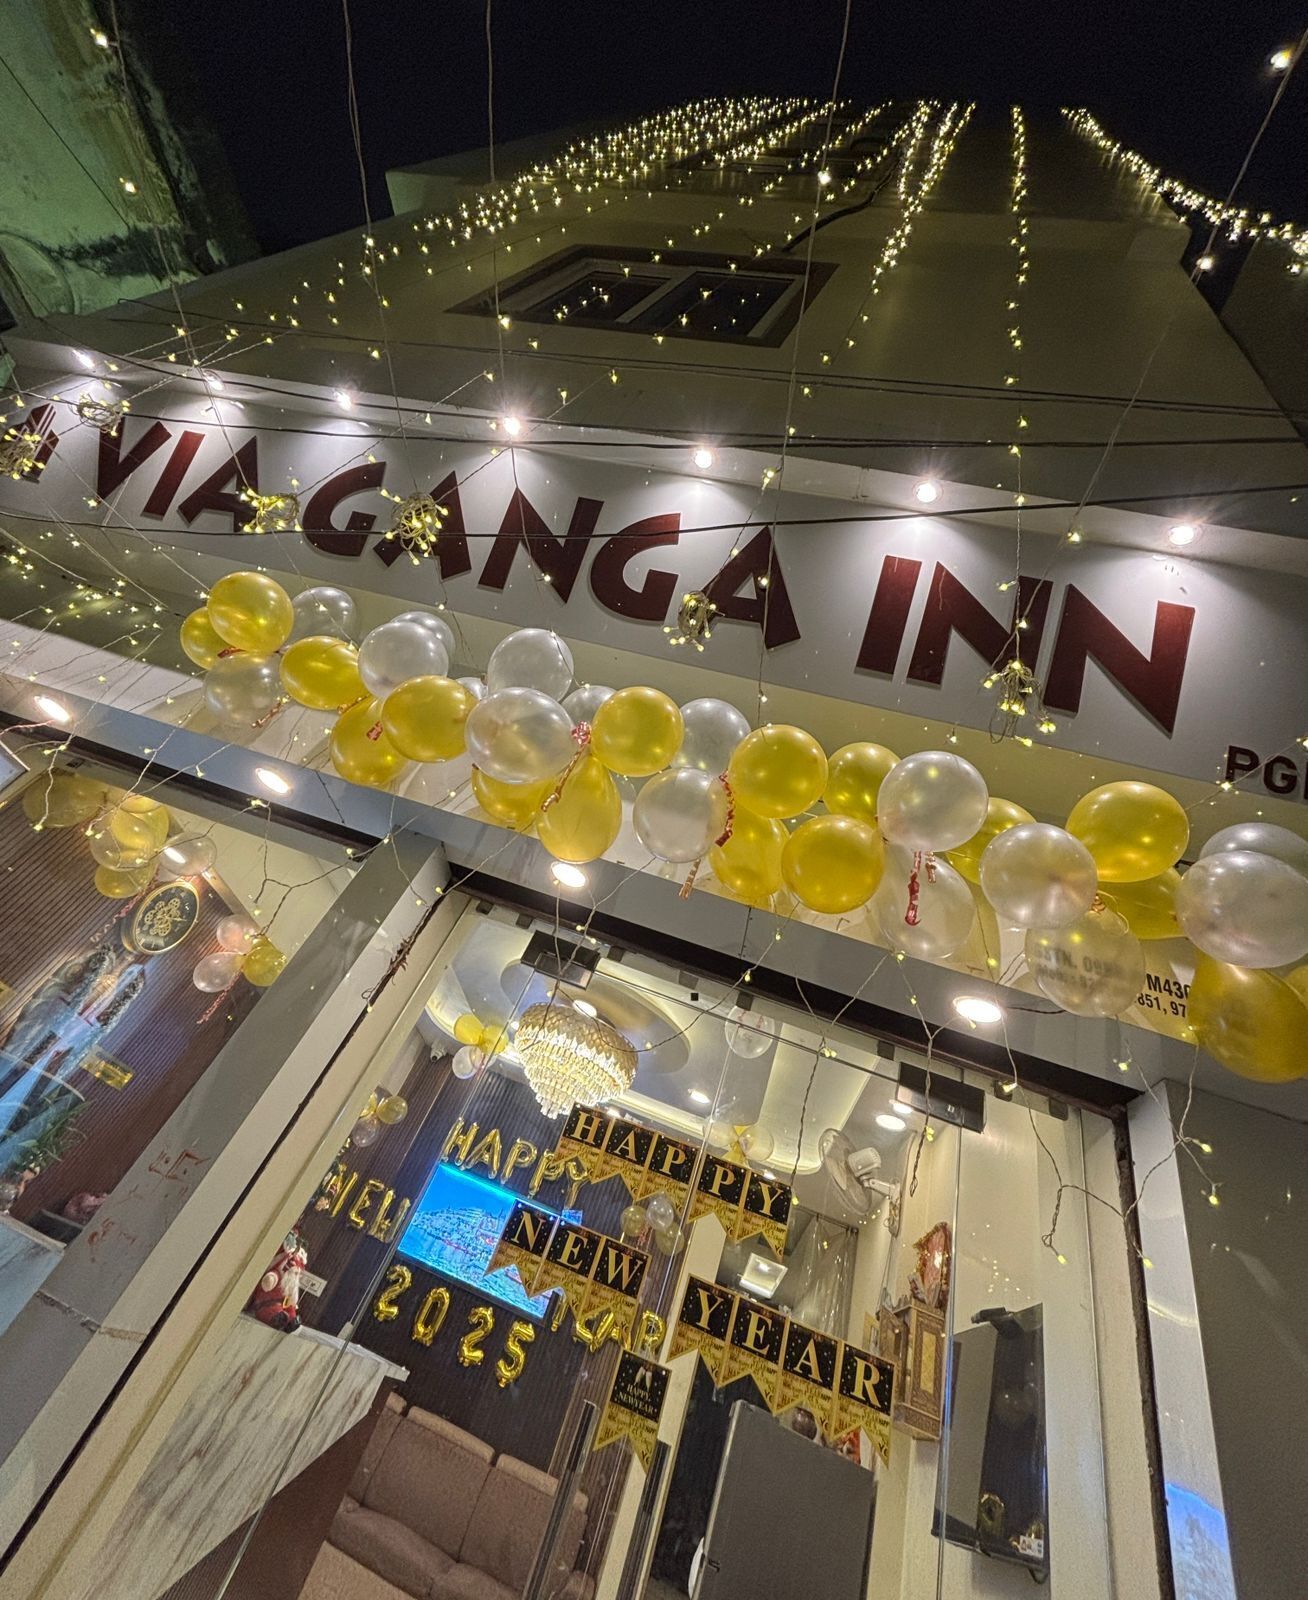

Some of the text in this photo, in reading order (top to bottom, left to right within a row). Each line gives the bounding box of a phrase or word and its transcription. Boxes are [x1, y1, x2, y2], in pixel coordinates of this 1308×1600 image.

[854, 554, 1195, 738] INN
[1225, 745, 1308, 800] PG
[440, 1116, 590, 1208] HAPPY
[571, 1110, 784, 1218] HAPPY
[511, 1210, 644, 1291] NEW
[373, 1264, 536, 1387] 2025
[696, 1287, 882, 1408] YEAR
